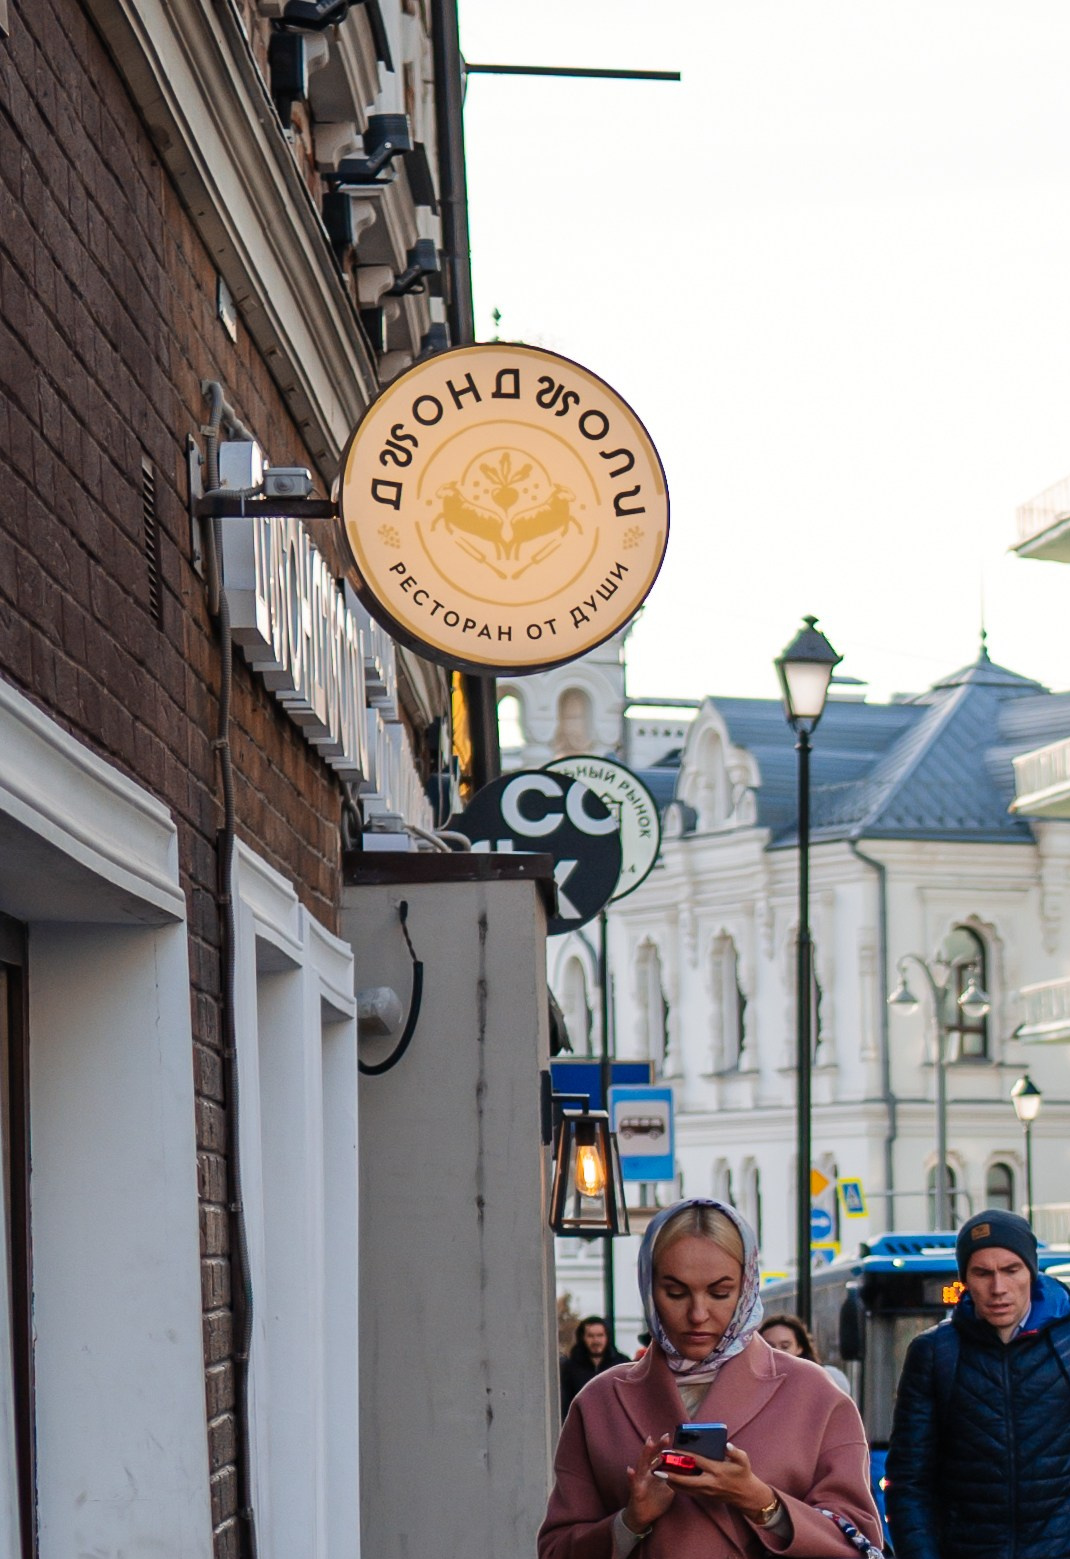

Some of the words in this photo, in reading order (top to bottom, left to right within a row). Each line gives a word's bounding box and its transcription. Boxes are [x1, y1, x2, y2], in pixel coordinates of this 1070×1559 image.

[389, 562, 513, 642] РЕСТОРАН
[526, 618, 557, 641] ОТ
[569, 561, 630, 629] ДУШИ
[560, 765, 617, 785] ЬНЫЙ
[617, 779, 652, 839] РЫНОК
